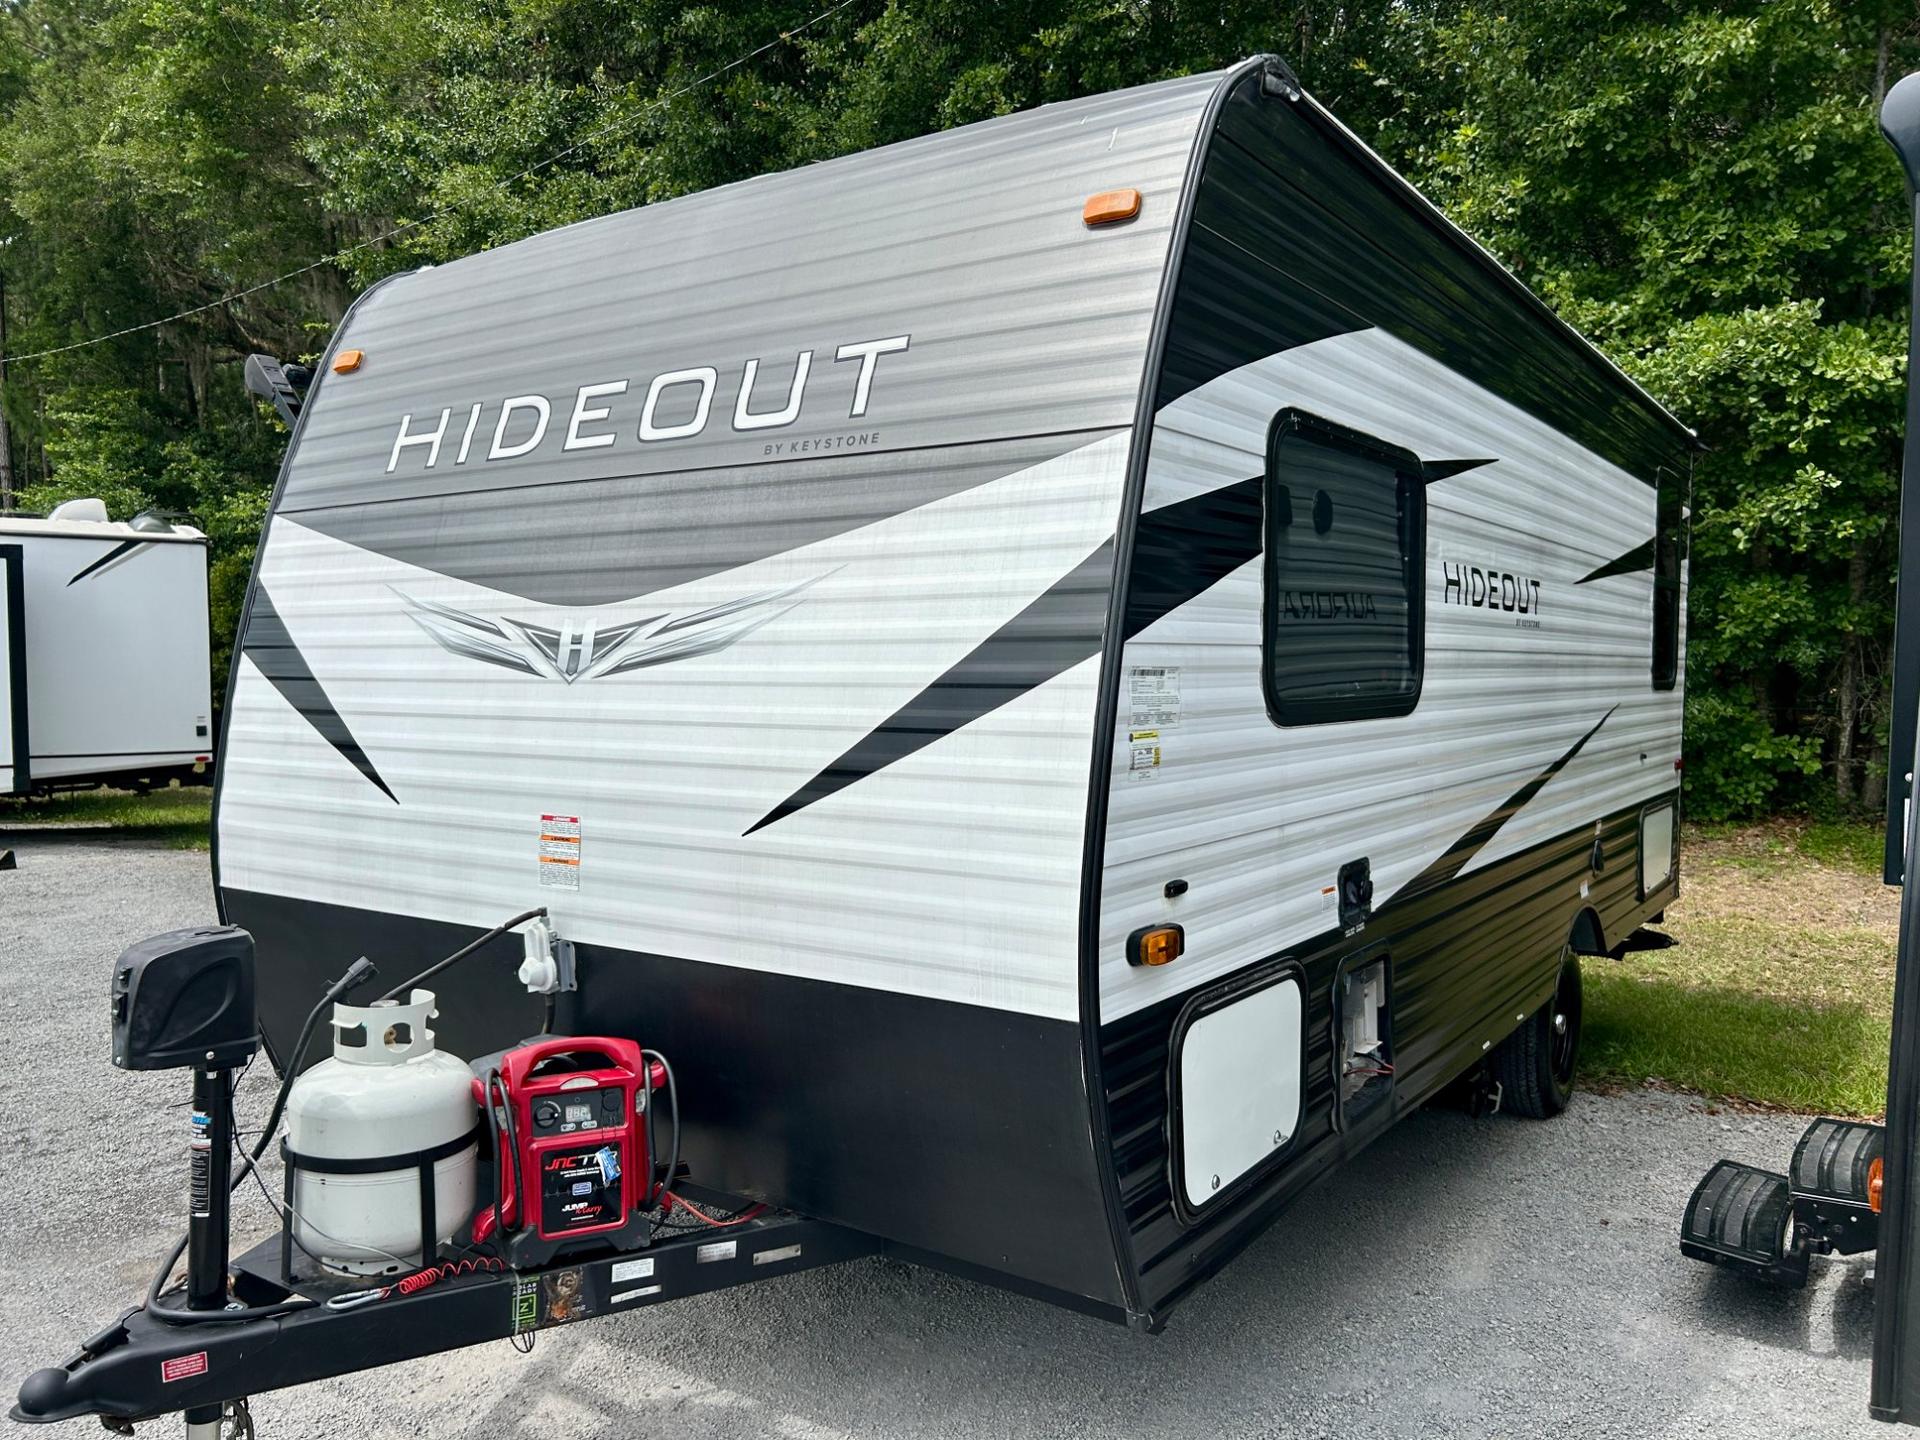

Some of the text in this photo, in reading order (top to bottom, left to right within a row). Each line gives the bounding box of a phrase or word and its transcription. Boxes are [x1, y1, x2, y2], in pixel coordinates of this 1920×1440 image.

[385, 333, 912, 474] HIDEOUT
[763, 431, 880, 456] BY KEYSTONE
[1443, 561, 1541, 616] HIDEOUT
